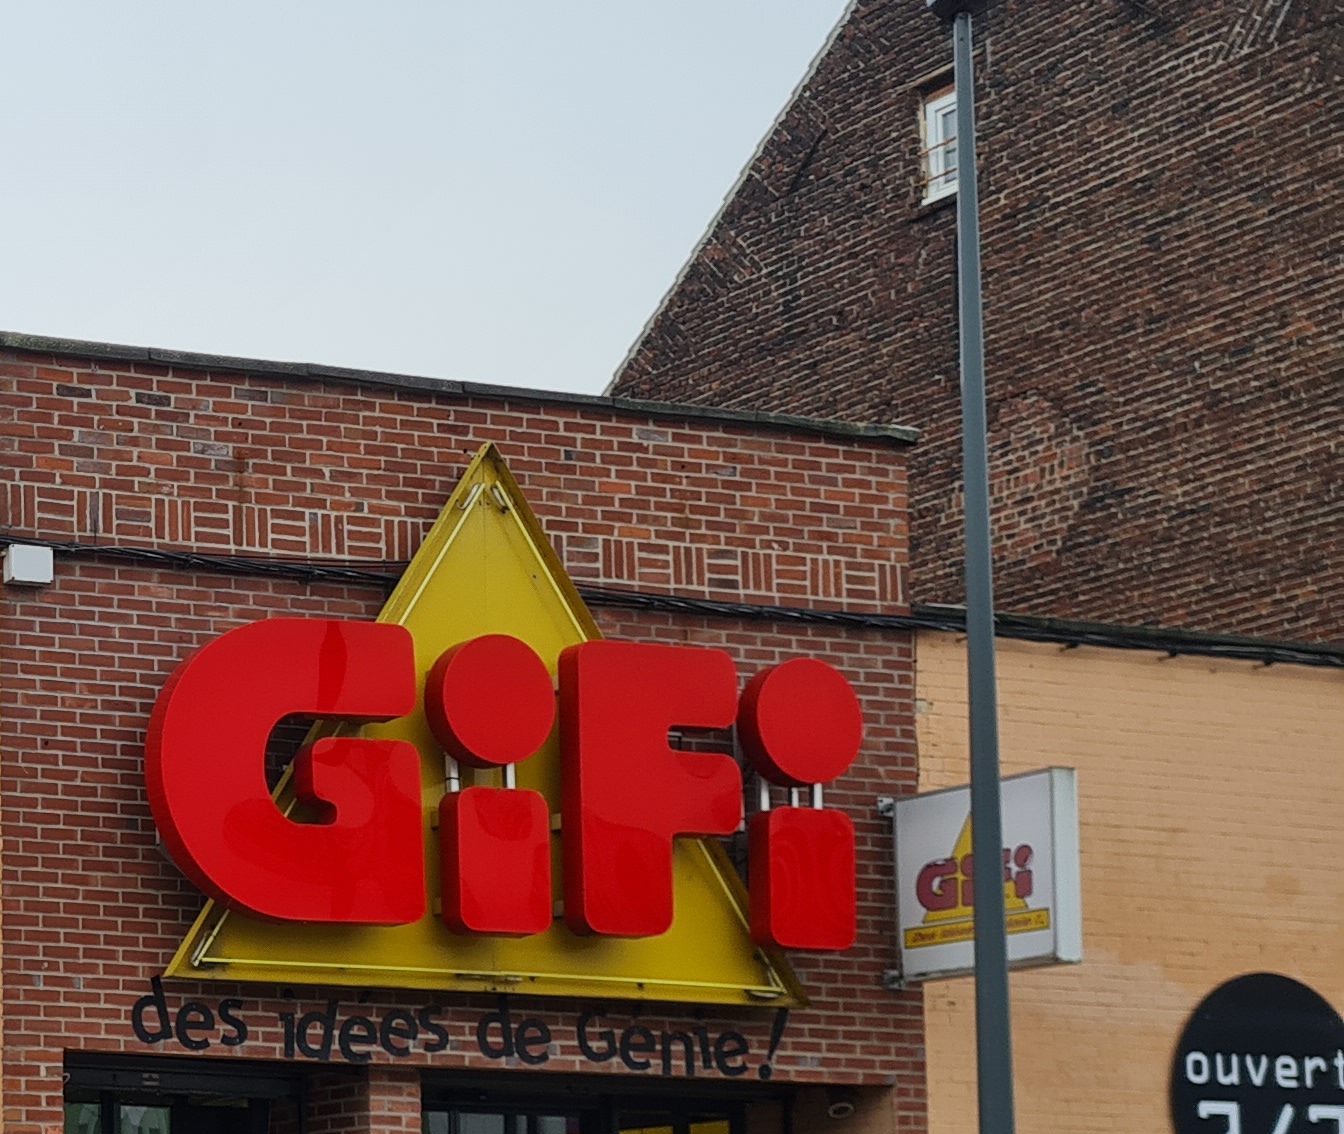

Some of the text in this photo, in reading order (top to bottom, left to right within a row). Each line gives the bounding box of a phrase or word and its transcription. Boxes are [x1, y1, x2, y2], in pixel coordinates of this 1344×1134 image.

[145, 618, 863, 950] GiFi
[131, 974, 249, 1051] des
[476, 993, 553, 1065] de
